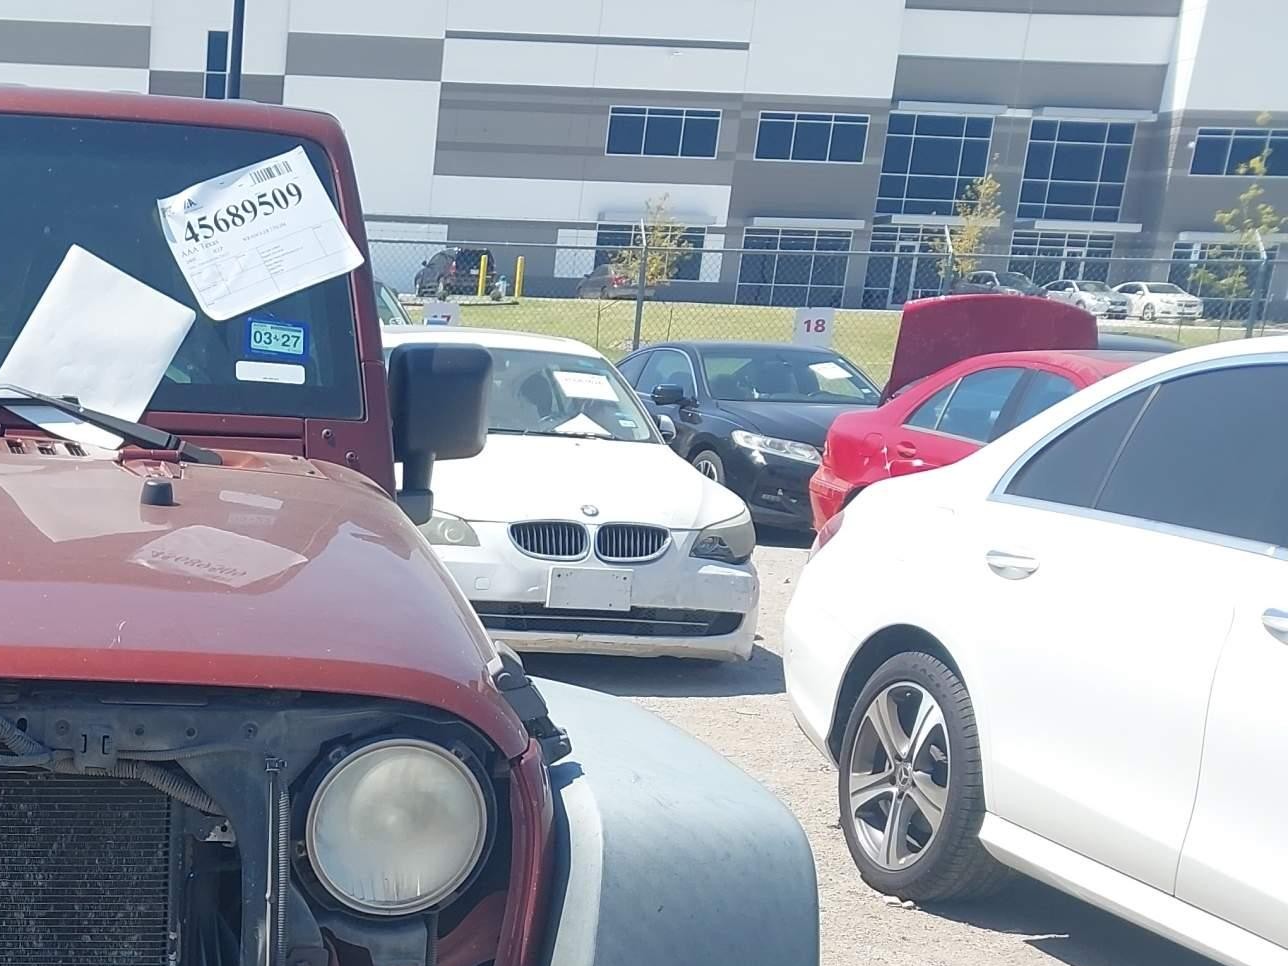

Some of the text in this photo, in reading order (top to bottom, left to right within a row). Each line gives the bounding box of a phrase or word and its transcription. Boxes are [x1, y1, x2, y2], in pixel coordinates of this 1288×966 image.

[184, 182, 303, 243] 45689509
[803, 318, 826, 333] 18
[253, 330, 301, 348] 03 27
